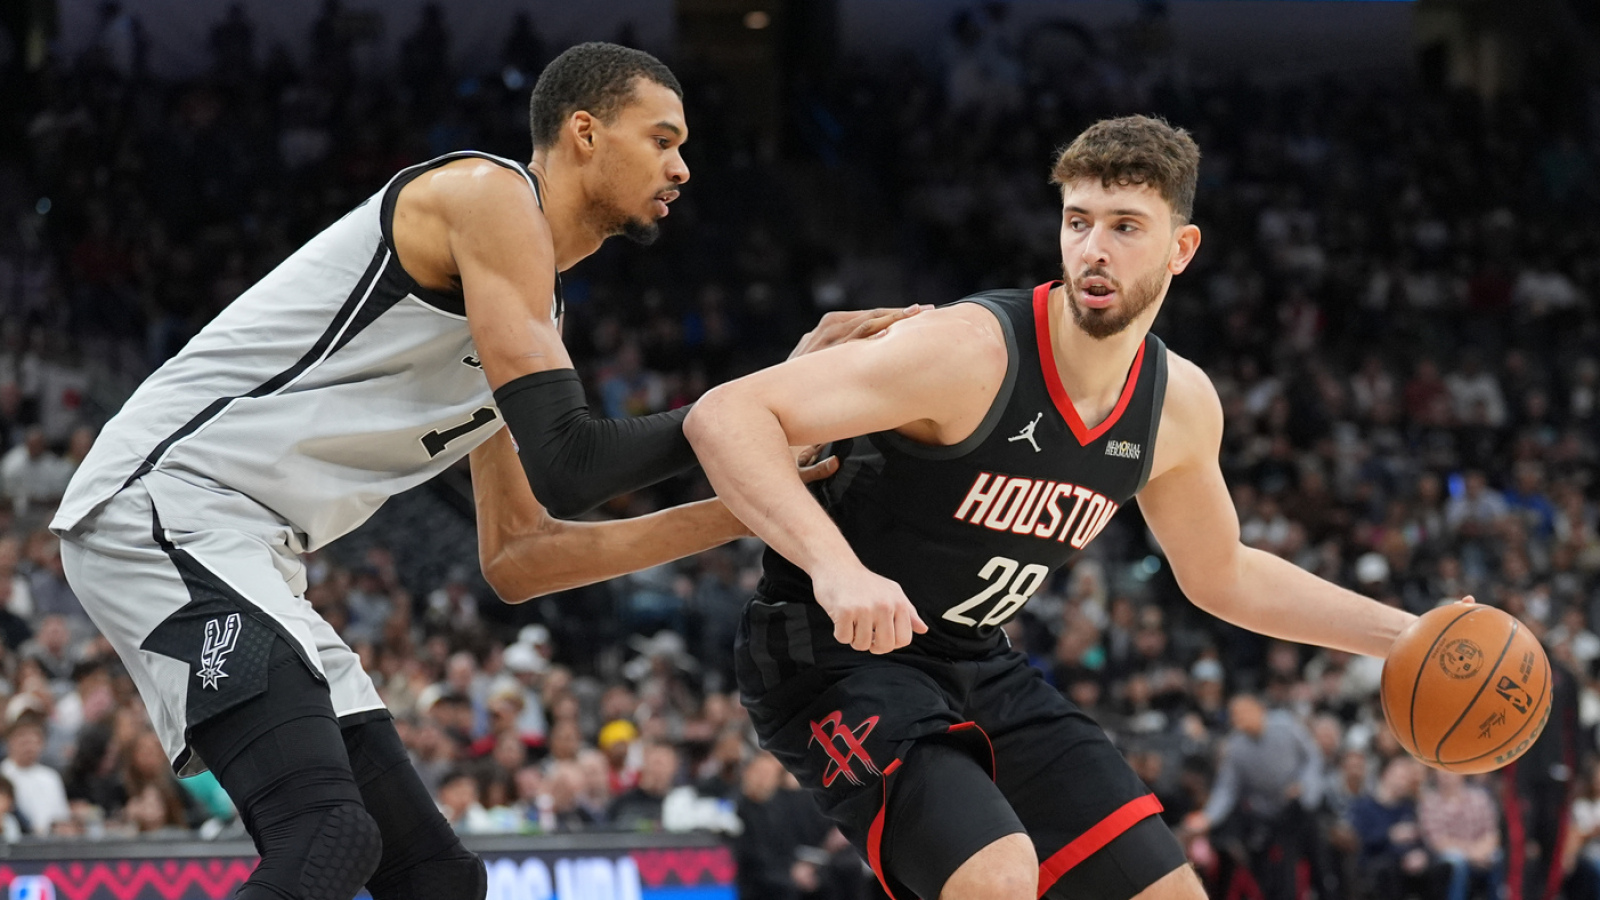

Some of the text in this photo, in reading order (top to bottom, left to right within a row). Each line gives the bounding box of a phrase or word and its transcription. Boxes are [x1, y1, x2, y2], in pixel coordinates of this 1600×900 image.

[419, 406, 498, 460] 1
[953, 472, 1119, 550] HOUSTON
[941, 556, 1049, 628] 28
